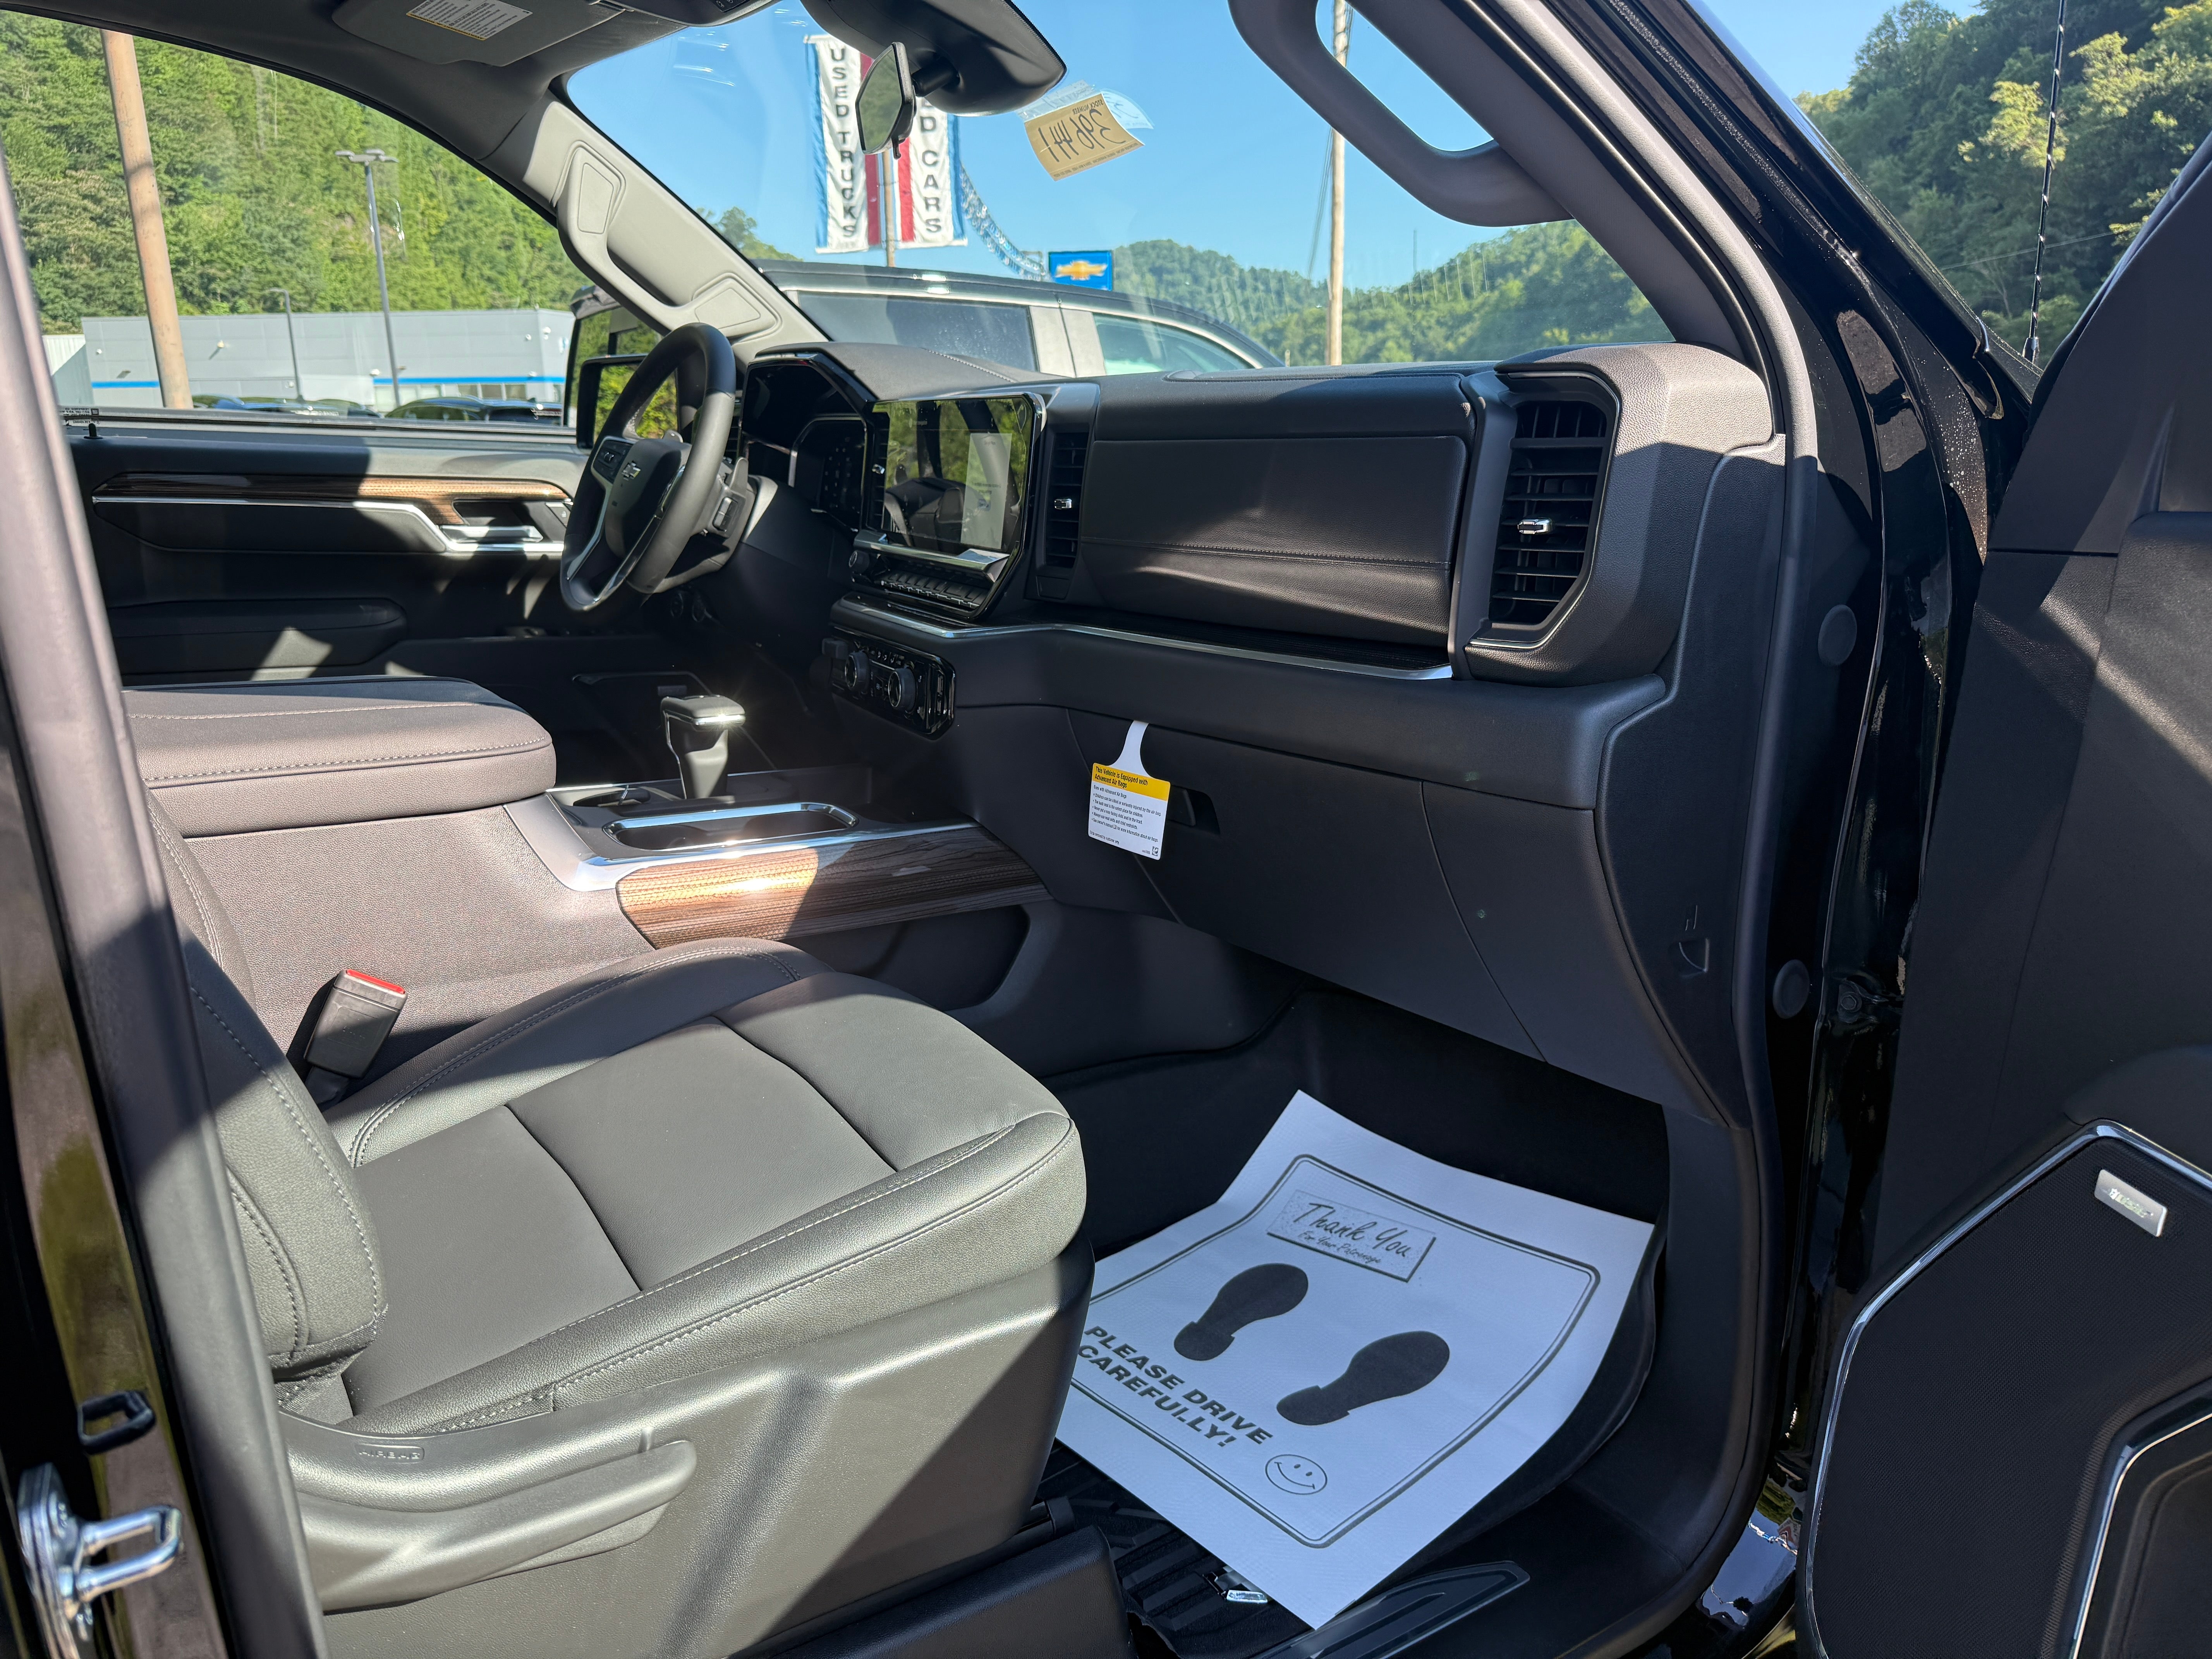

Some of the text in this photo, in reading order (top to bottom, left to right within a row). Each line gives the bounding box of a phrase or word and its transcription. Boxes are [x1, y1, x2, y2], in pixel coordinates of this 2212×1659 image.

[831, 47, 856, 237] USED TRUCKS
[922, 150, 941, 233] CARS
[1095, 774, 1111, 783] Advanced
[1118, 780, 1127, 788] Bags
[1103, 768, 1116, 777] Vehicle
[1120, 773, 1138, 784] Equipped
[1293, 1203, 1411, 1257] Thank You
[1298, 1230, 1381, 1264] For Your Patronage
[1077, 1345, 1237, 1447] CAREFULLY!
[1084, 1326, 1274, 1444] PLEASE DRIVE
[359, 1450, 420, 1460] AIRBAG
